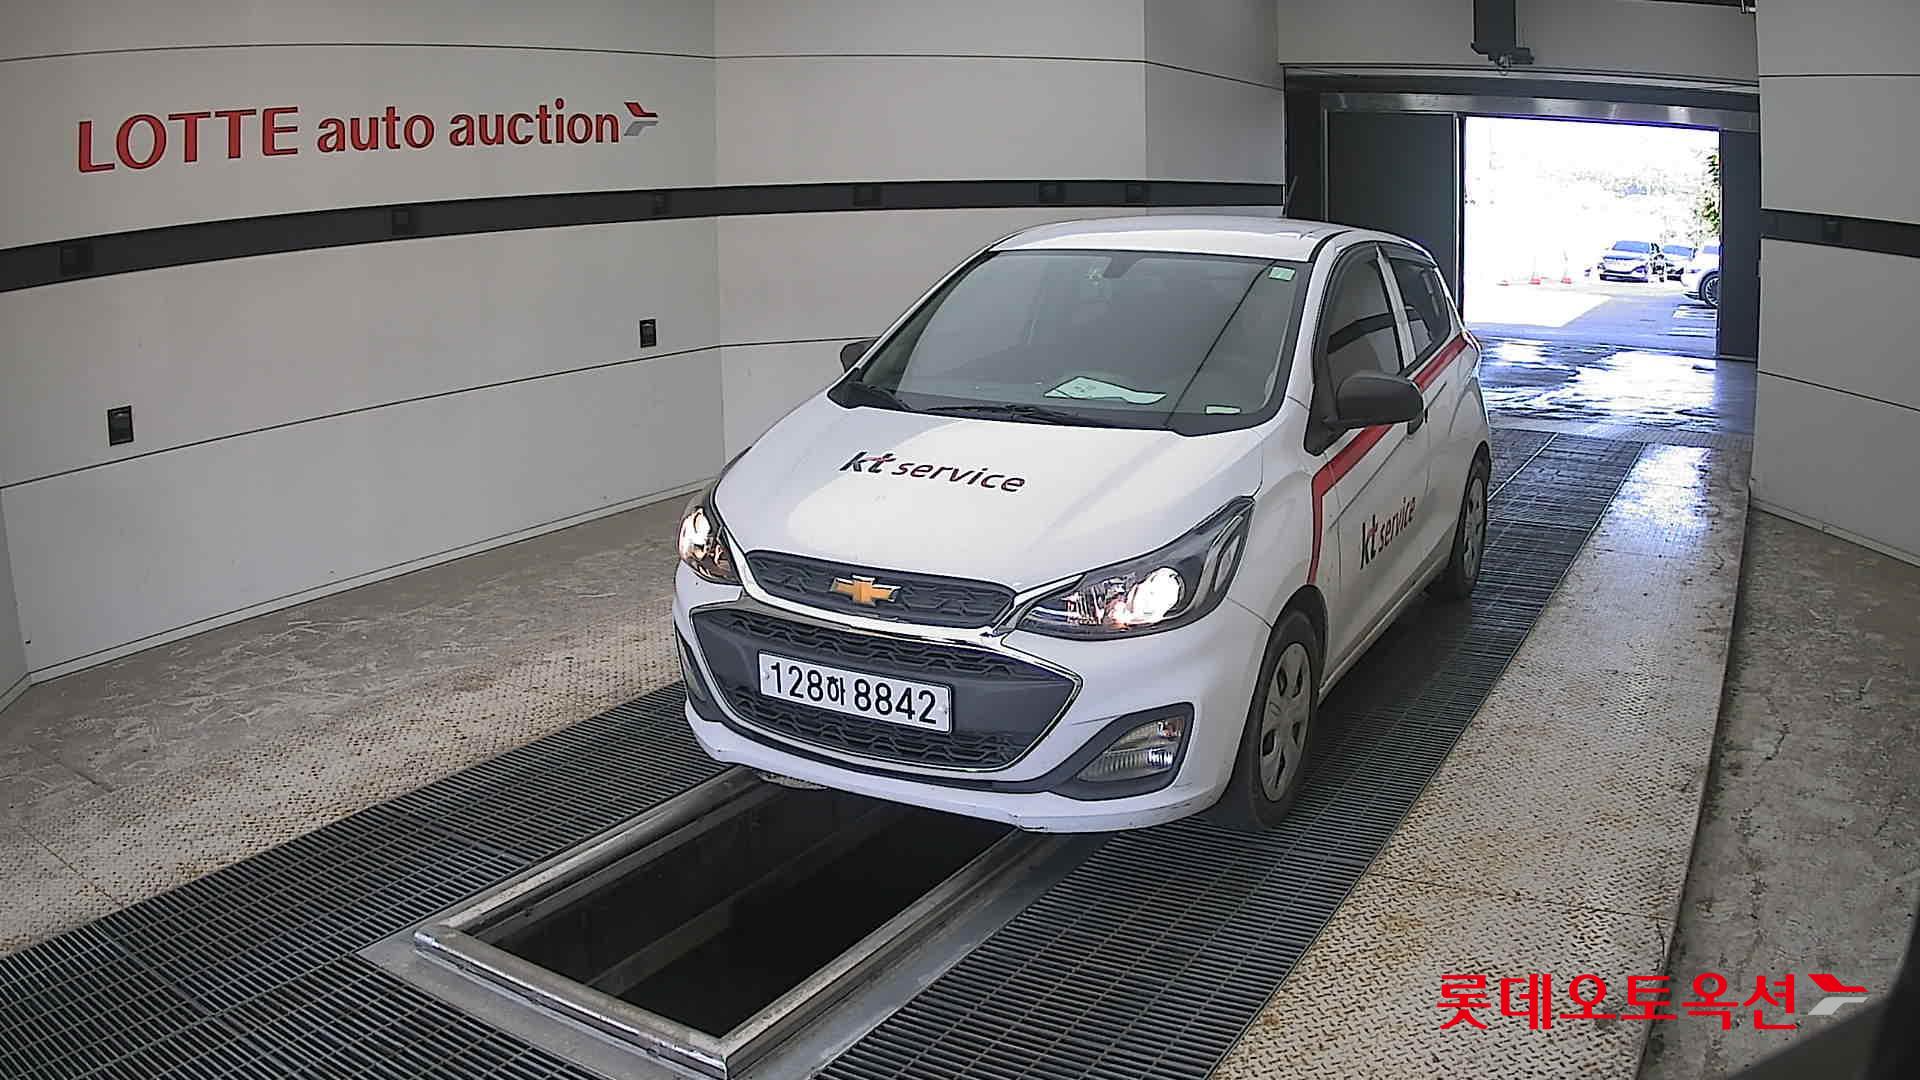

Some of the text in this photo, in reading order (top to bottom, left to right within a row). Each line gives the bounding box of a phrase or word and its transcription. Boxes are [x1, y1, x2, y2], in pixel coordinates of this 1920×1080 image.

[78, 98, 620, 173] LOTTE auto auction
[839, 451, 1026, 493] kt service
[1360, 496, 1416, 570] kt service
[770, 661, 938, 725] 128하 8842
